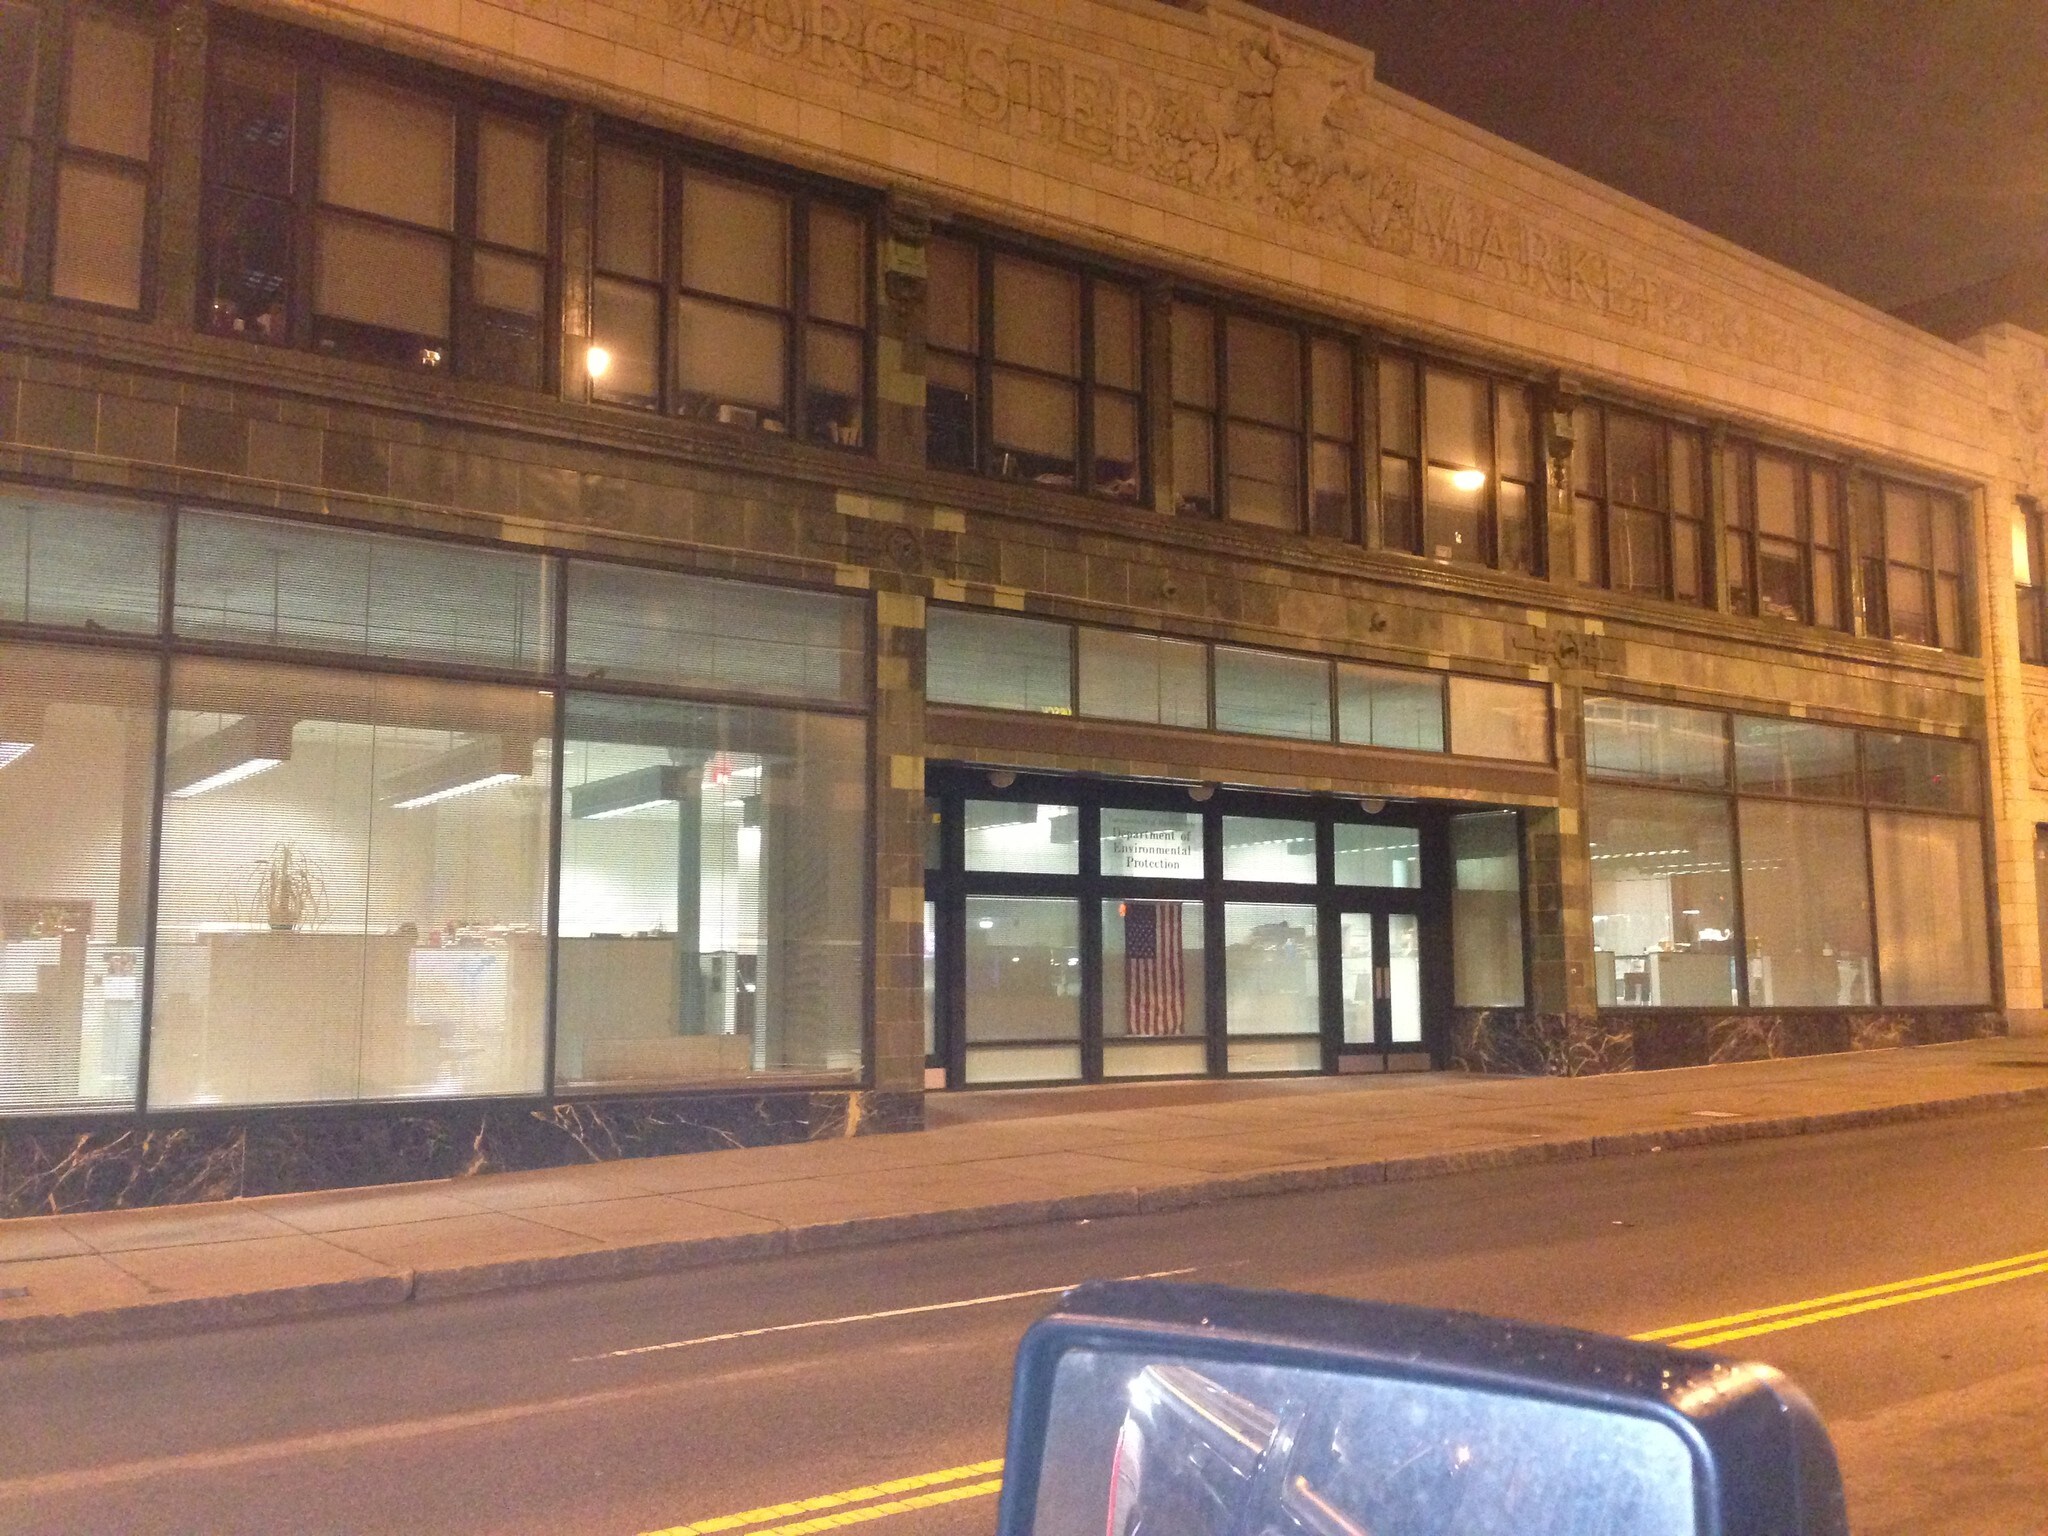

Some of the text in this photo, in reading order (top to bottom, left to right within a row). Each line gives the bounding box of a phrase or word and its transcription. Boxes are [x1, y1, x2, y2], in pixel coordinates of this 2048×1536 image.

[1112, 827, 1191, 842] Department of
[1113, 842, 1191, 856] Environmental
[1126, 856, 1180, 869] Protection
